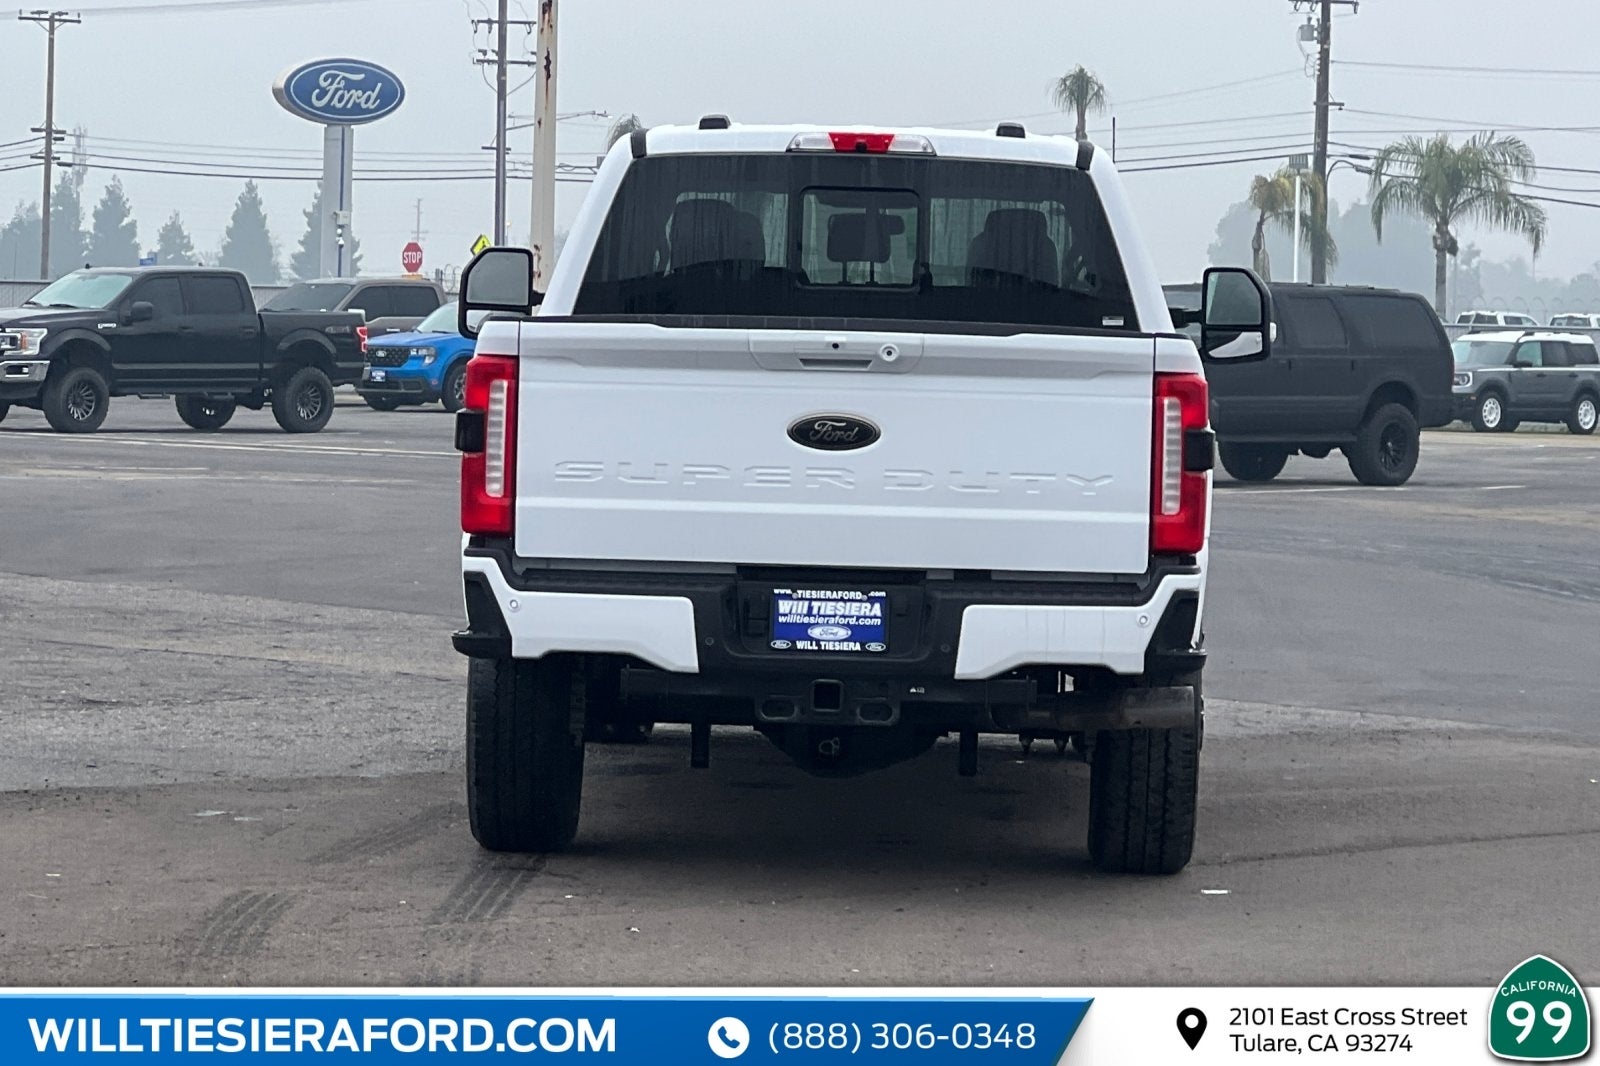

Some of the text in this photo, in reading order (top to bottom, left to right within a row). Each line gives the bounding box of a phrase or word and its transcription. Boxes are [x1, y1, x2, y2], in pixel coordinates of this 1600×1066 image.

[311, 70, 382, 109] Ford
[403, 251, 422, 264] STOP
[809, 420, 859, 441] Ford
[554, 460, 1114, 496] SUPER DUTY
[796, 590, 863, 600] TIESIERAFORD
[811, 601, 882, 616] TIESIERA
[778, 614, 881, 625] willtiesieraford.com
[796, 640, 861, 651] WILL TIESIERA
